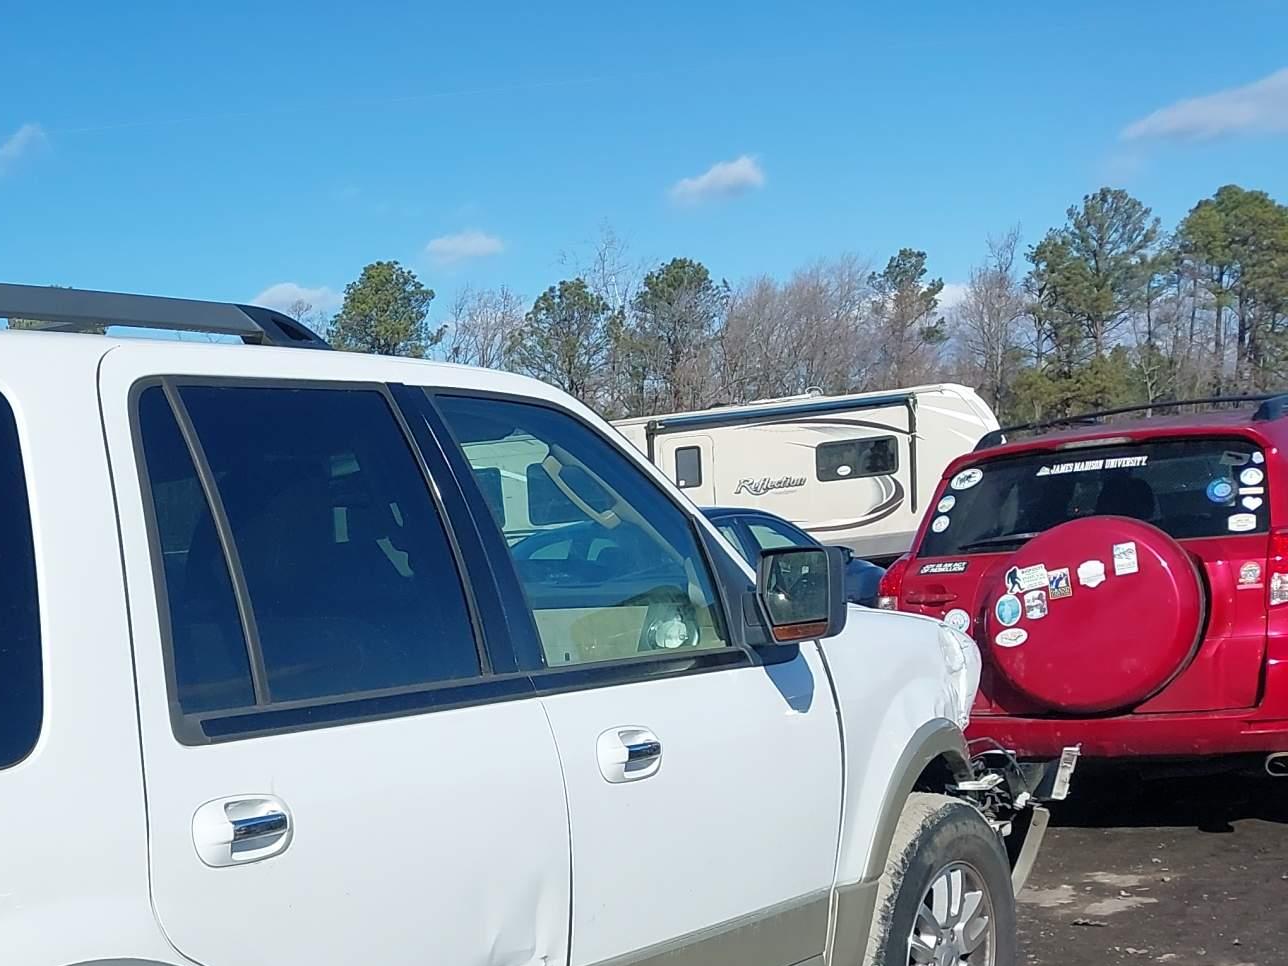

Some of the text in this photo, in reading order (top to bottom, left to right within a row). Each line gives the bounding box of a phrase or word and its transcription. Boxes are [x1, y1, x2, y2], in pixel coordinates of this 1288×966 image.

[1051, 456, 1148, 474] JAMES MADISON UNIVERSITY
[734, 475, 807, 496] Reflection
